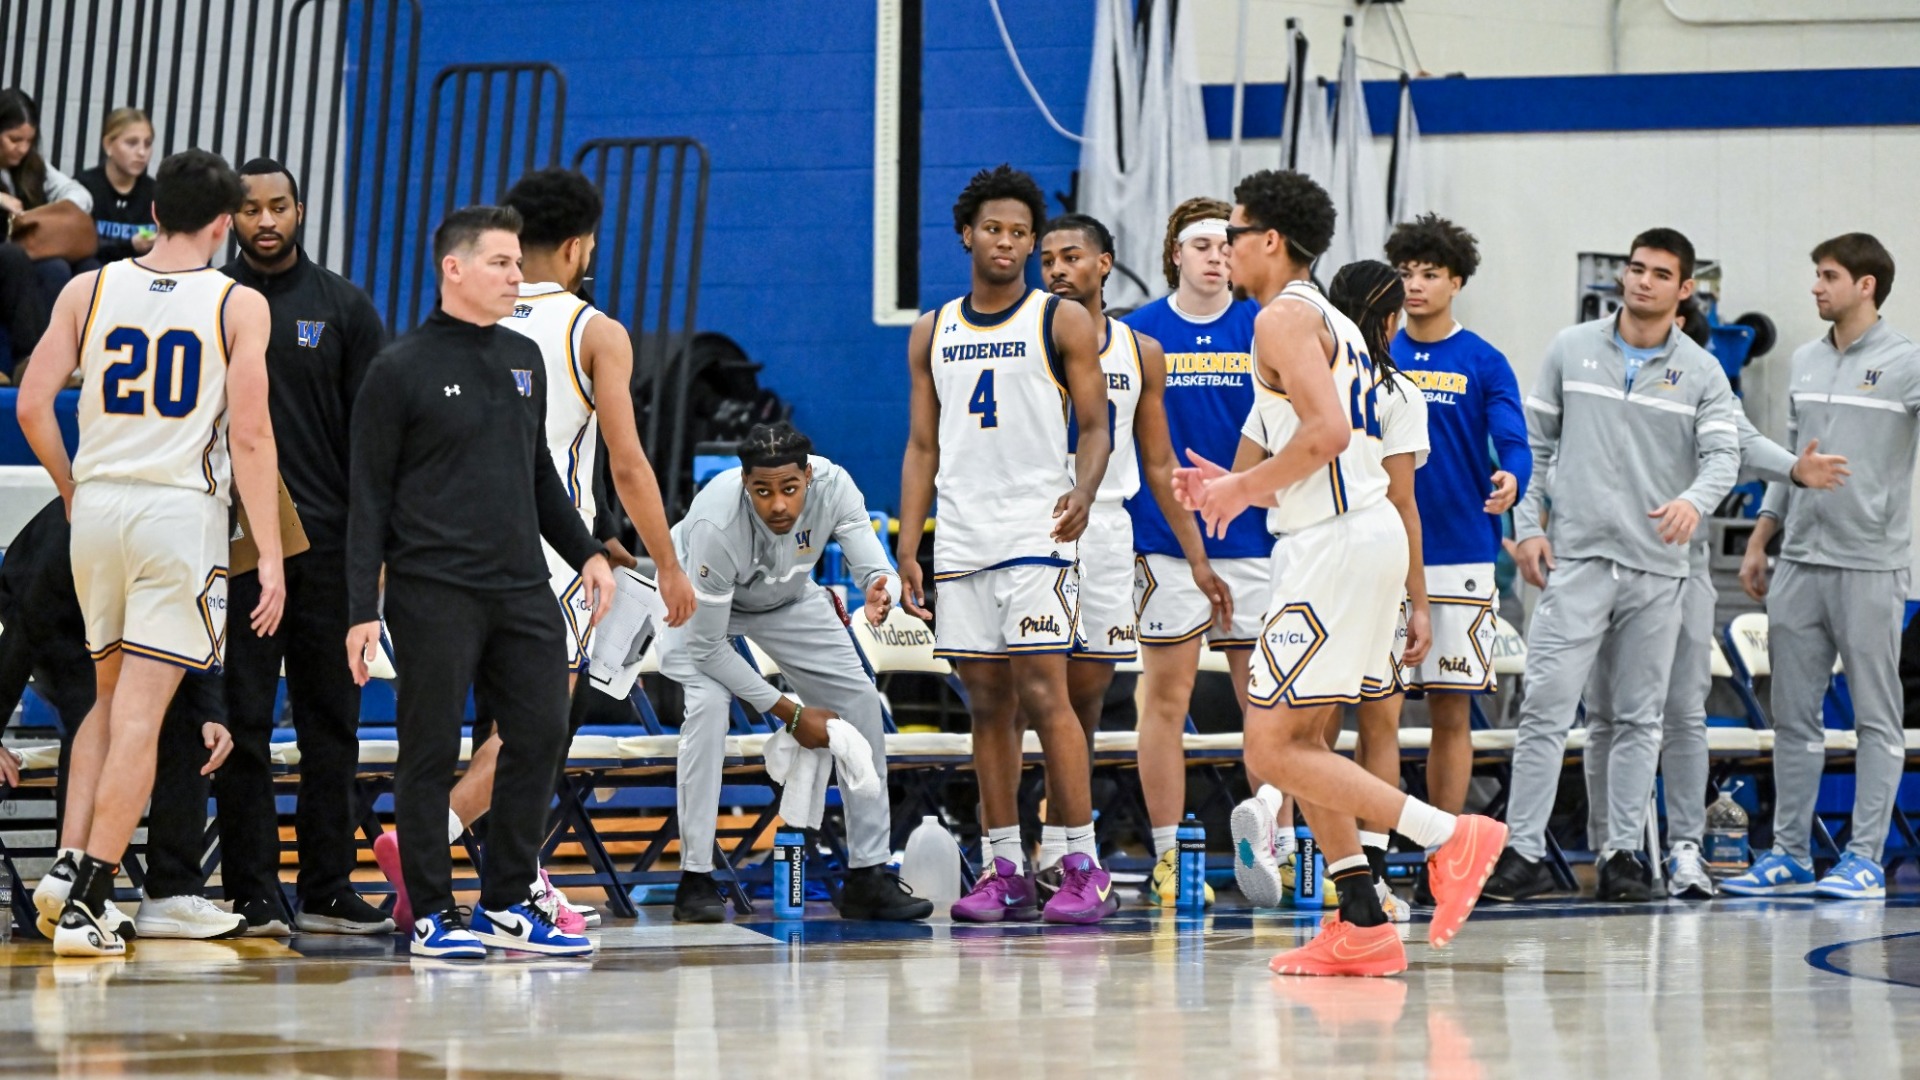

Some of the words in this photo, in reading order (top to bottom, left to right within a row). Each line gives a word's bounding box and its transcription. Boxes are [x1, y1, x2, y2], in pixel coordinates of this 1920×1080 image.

[297, 320, 325, 348] W
[942, 342, 1026, 363] WIDENER
[104, 325, 203, 418] 20
[511, 369, 532, 397] W
[1165, 374, 1244, 387] BASKETBALL
[968, 368, 998, 428] 4
[795, 529, 811, 550] W
[1020, 615, 1061, 637] Pride
[1107, 624, 1136, 646] Prid
[1270, 630, 1308, 647] 21/CL
[1438, 655, 1473, 678] Pride
[792, 846, 801, 904] POWERADE
[1304, 838, 1313, 896] POWERADE
